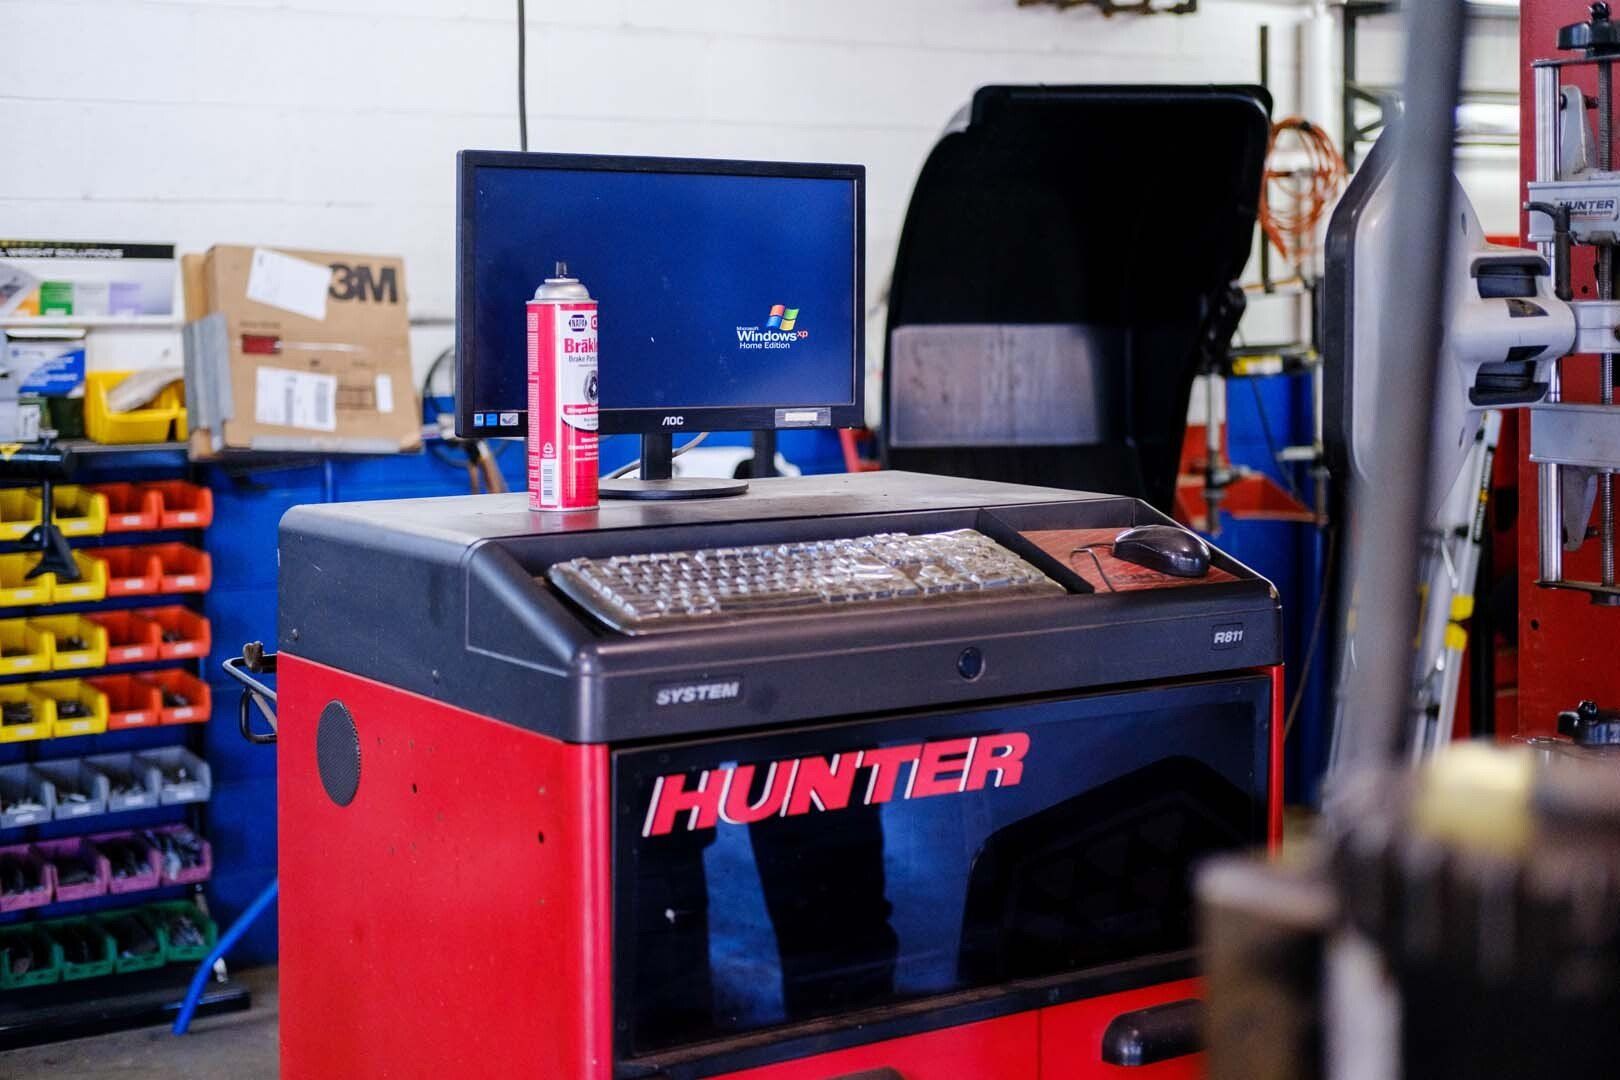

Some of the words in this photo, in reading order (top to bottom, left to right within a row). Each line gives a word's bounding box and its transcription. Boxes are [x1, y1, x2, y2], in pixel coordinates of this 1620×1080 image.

[1560, 200, 1615, 210] HUNTER
[328, 263, 398, 304] 3M
[737, 330, 797, 341] Windows
[797, 331, 808, 339] xp
[662, 416, 684, 426] AOC
[1214, 630, 1244, 644] R811
[655, 681, 740, 706] SYSTEM
[642, 732, 1031, 838] HUNTER
